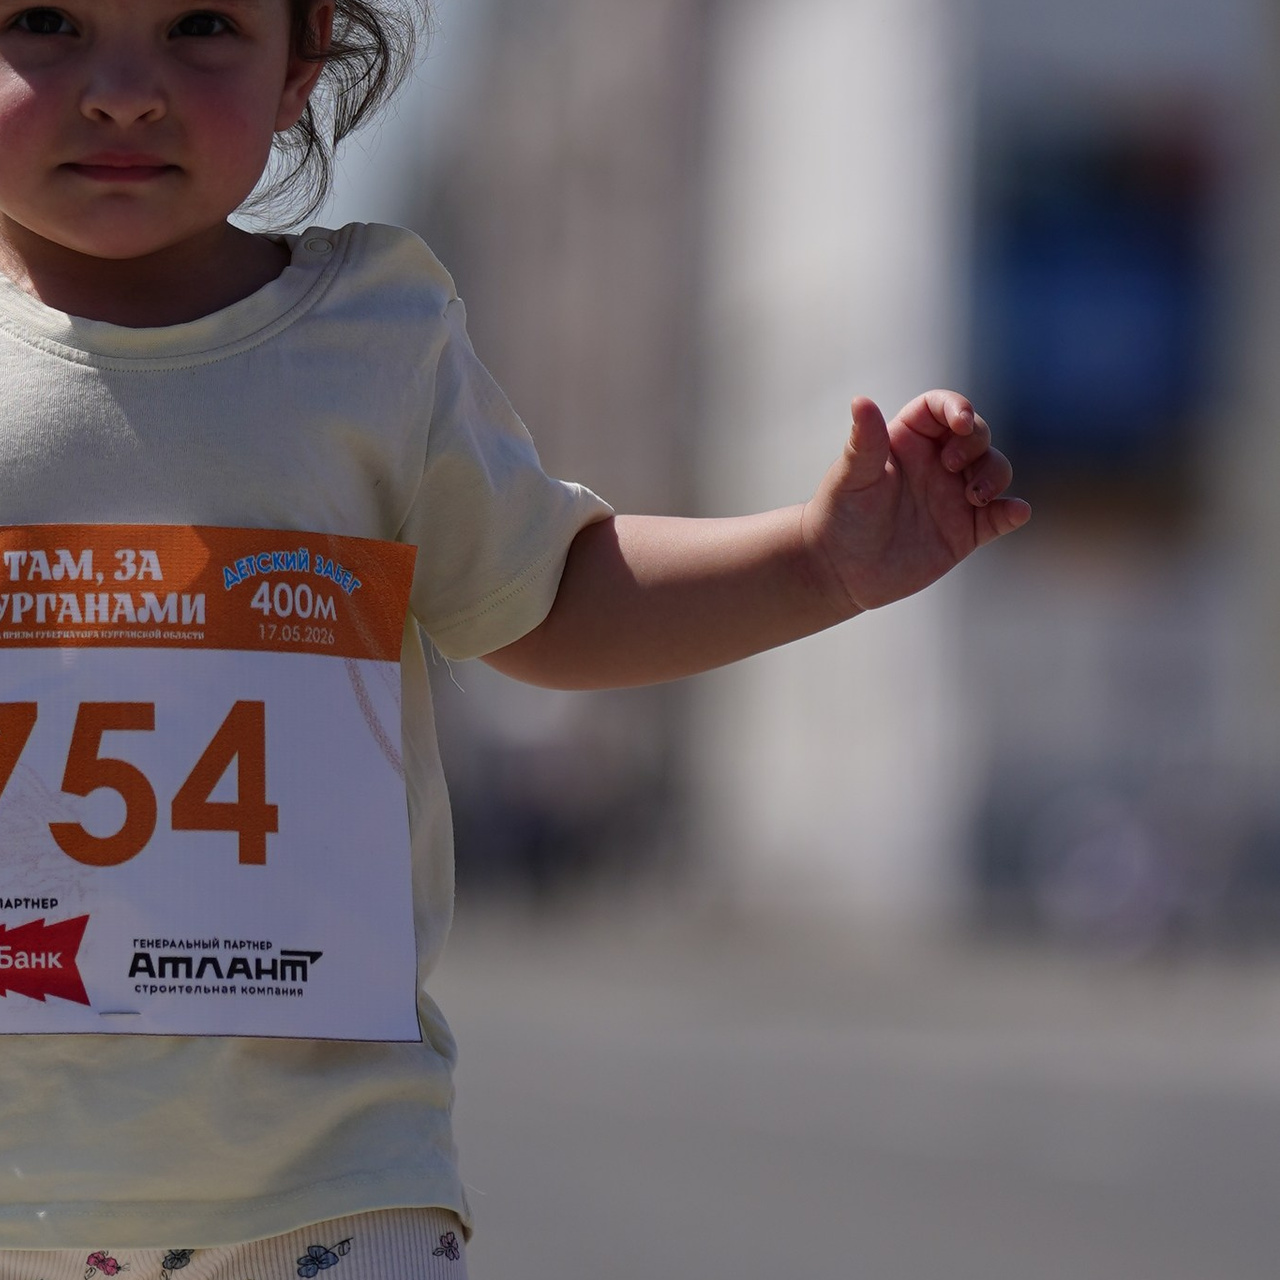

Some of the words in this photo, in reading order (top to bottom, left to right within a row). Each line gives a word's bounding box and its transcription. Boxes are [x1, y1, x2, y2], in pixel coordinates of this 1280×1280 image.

[4, 549, 105, 585] ТАМ,
[114, 549, 164, 581] ЗА
[222, 547, 310, 590] ДЕТСКИЙ
[315, 556, 362, 596] ЗАБЕГ
[259, 624, 335, 645] 17.05.2026
[133, 937, 220, 950] ГЕНЕРАЛЬНЫЙ
[224, 939, 273, 951] ПАРТНЕР
[134, 984, 237, 996] строительная
[241, 986, 304, 998] компания
